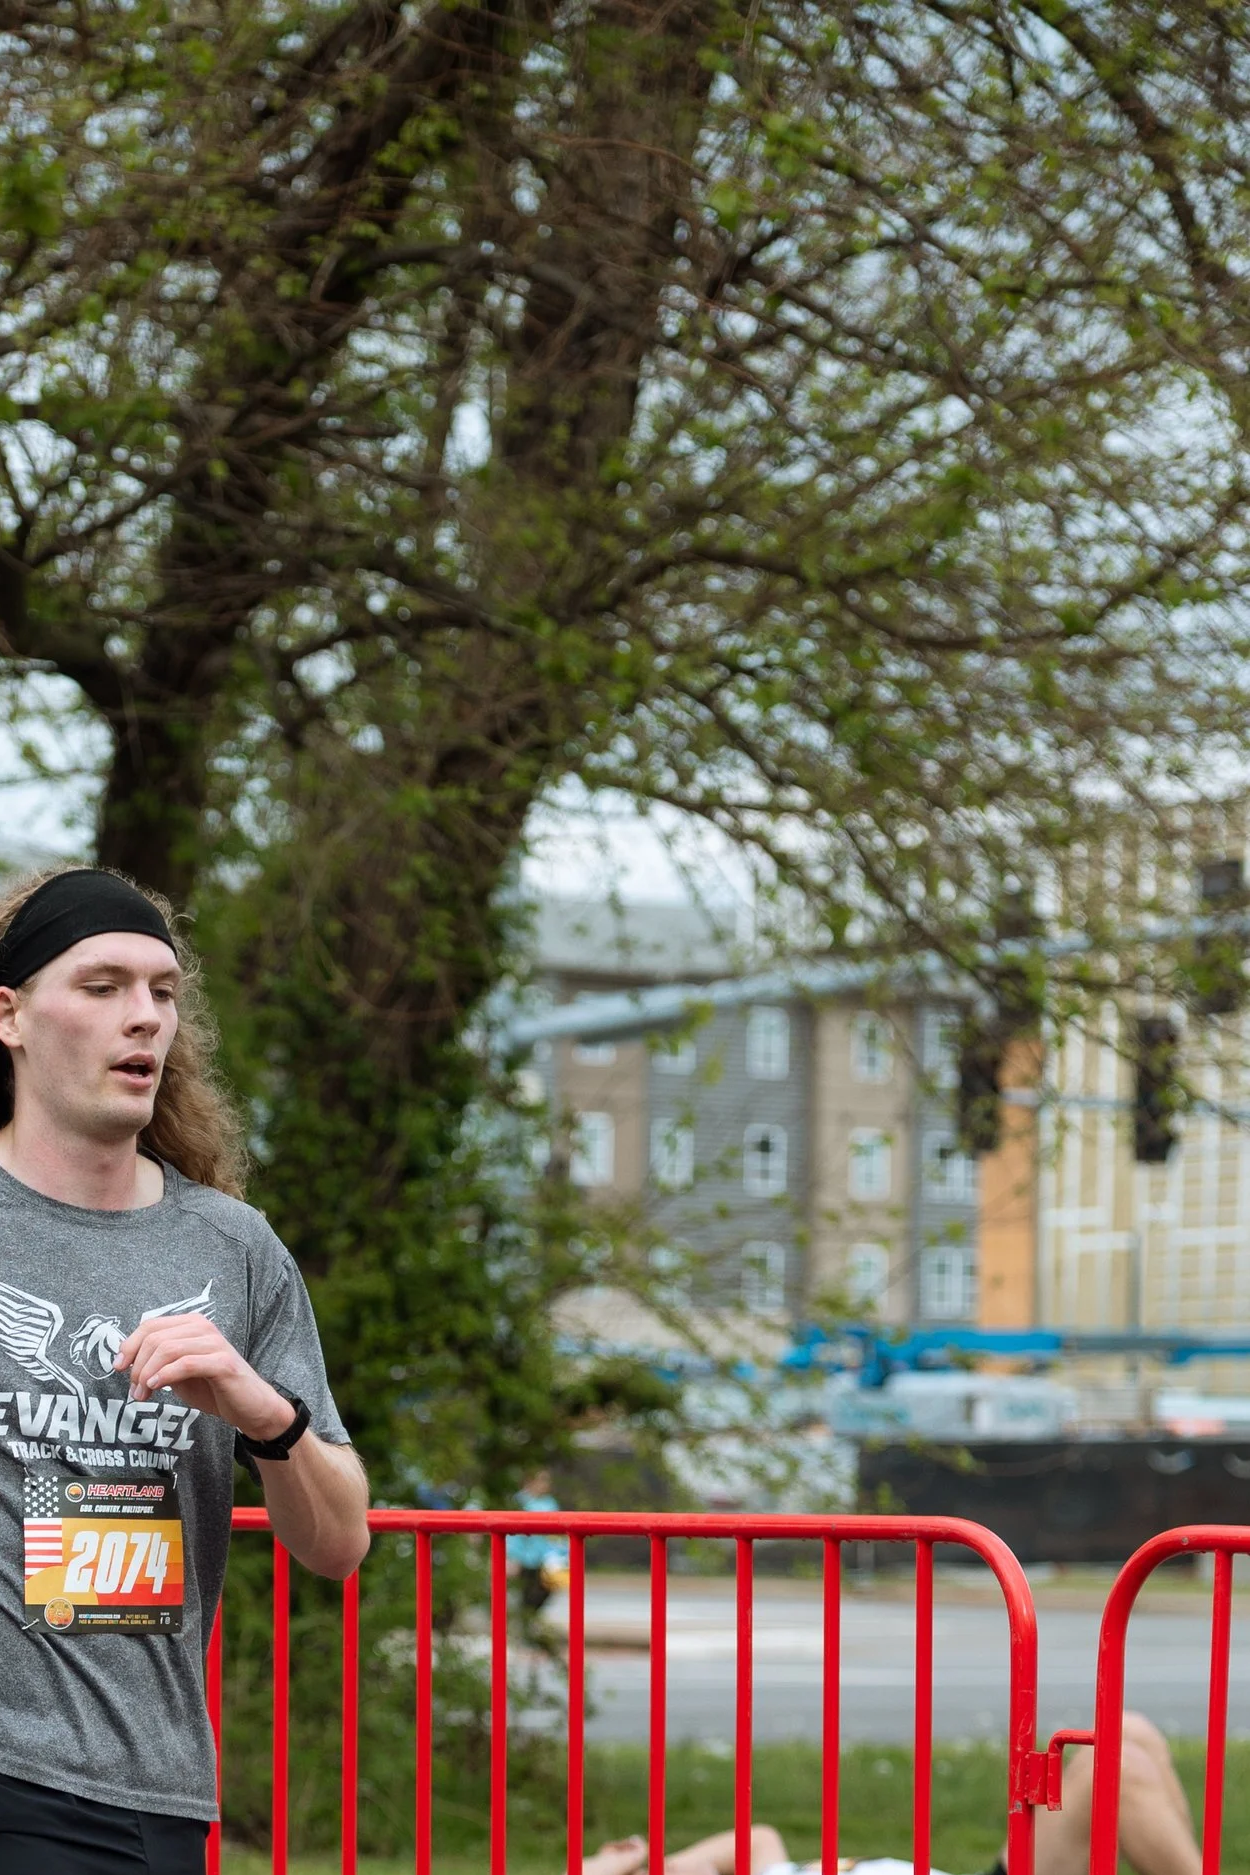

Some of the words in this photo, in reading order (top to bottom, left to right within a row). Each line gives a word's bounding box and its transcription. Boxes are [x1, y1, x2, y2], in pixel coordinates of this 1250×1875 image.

[7, 1441, 62, 1460] TRACK
[78, 1447, 126, 1468] CROSS
[87, 1484, 165, 1498] HEARTLAND
[63, 1530, 170, 1594] 2074
